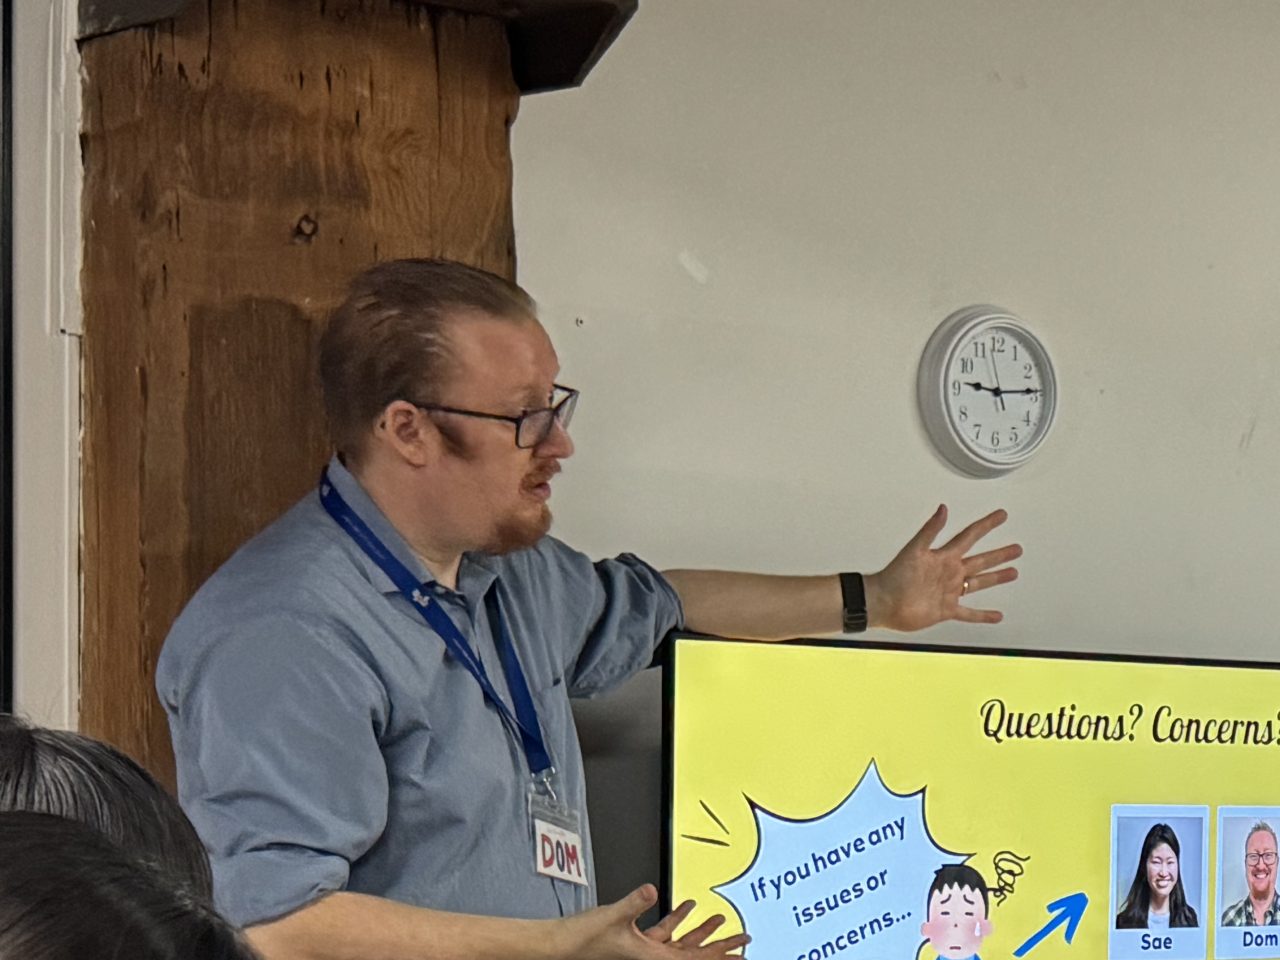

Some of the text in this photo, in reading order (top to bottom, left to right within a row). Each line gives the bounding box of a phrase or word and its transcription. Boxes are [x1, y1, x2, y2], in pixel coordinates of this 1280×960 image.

[973, 342, 986, 359] 11
[991, 336, 1005, 353] 12
[1012, 345, 1018, 361] 1
[960, 357, 974, 374] 10
[1023, 363, 1033, 379] 2
[952, 380, 961, 396] 9
[959, 405, 968, 422] 8
[1023, 410, 1031, 426] 4
[973, 424, 982, 440] 7
[991, 431, 1000, 447] 6
[1009, 426, 1018, 443] 5
[980, 698, 1144, 744] Questions?
[541, 833, 581, 877] DOM
[750, 816, 905, 902] If you have any
[792, 869, 888, 927] issues or
[1140, 933, 1173, 950] Sae
[1242, 931, 1279, 947] Dom
